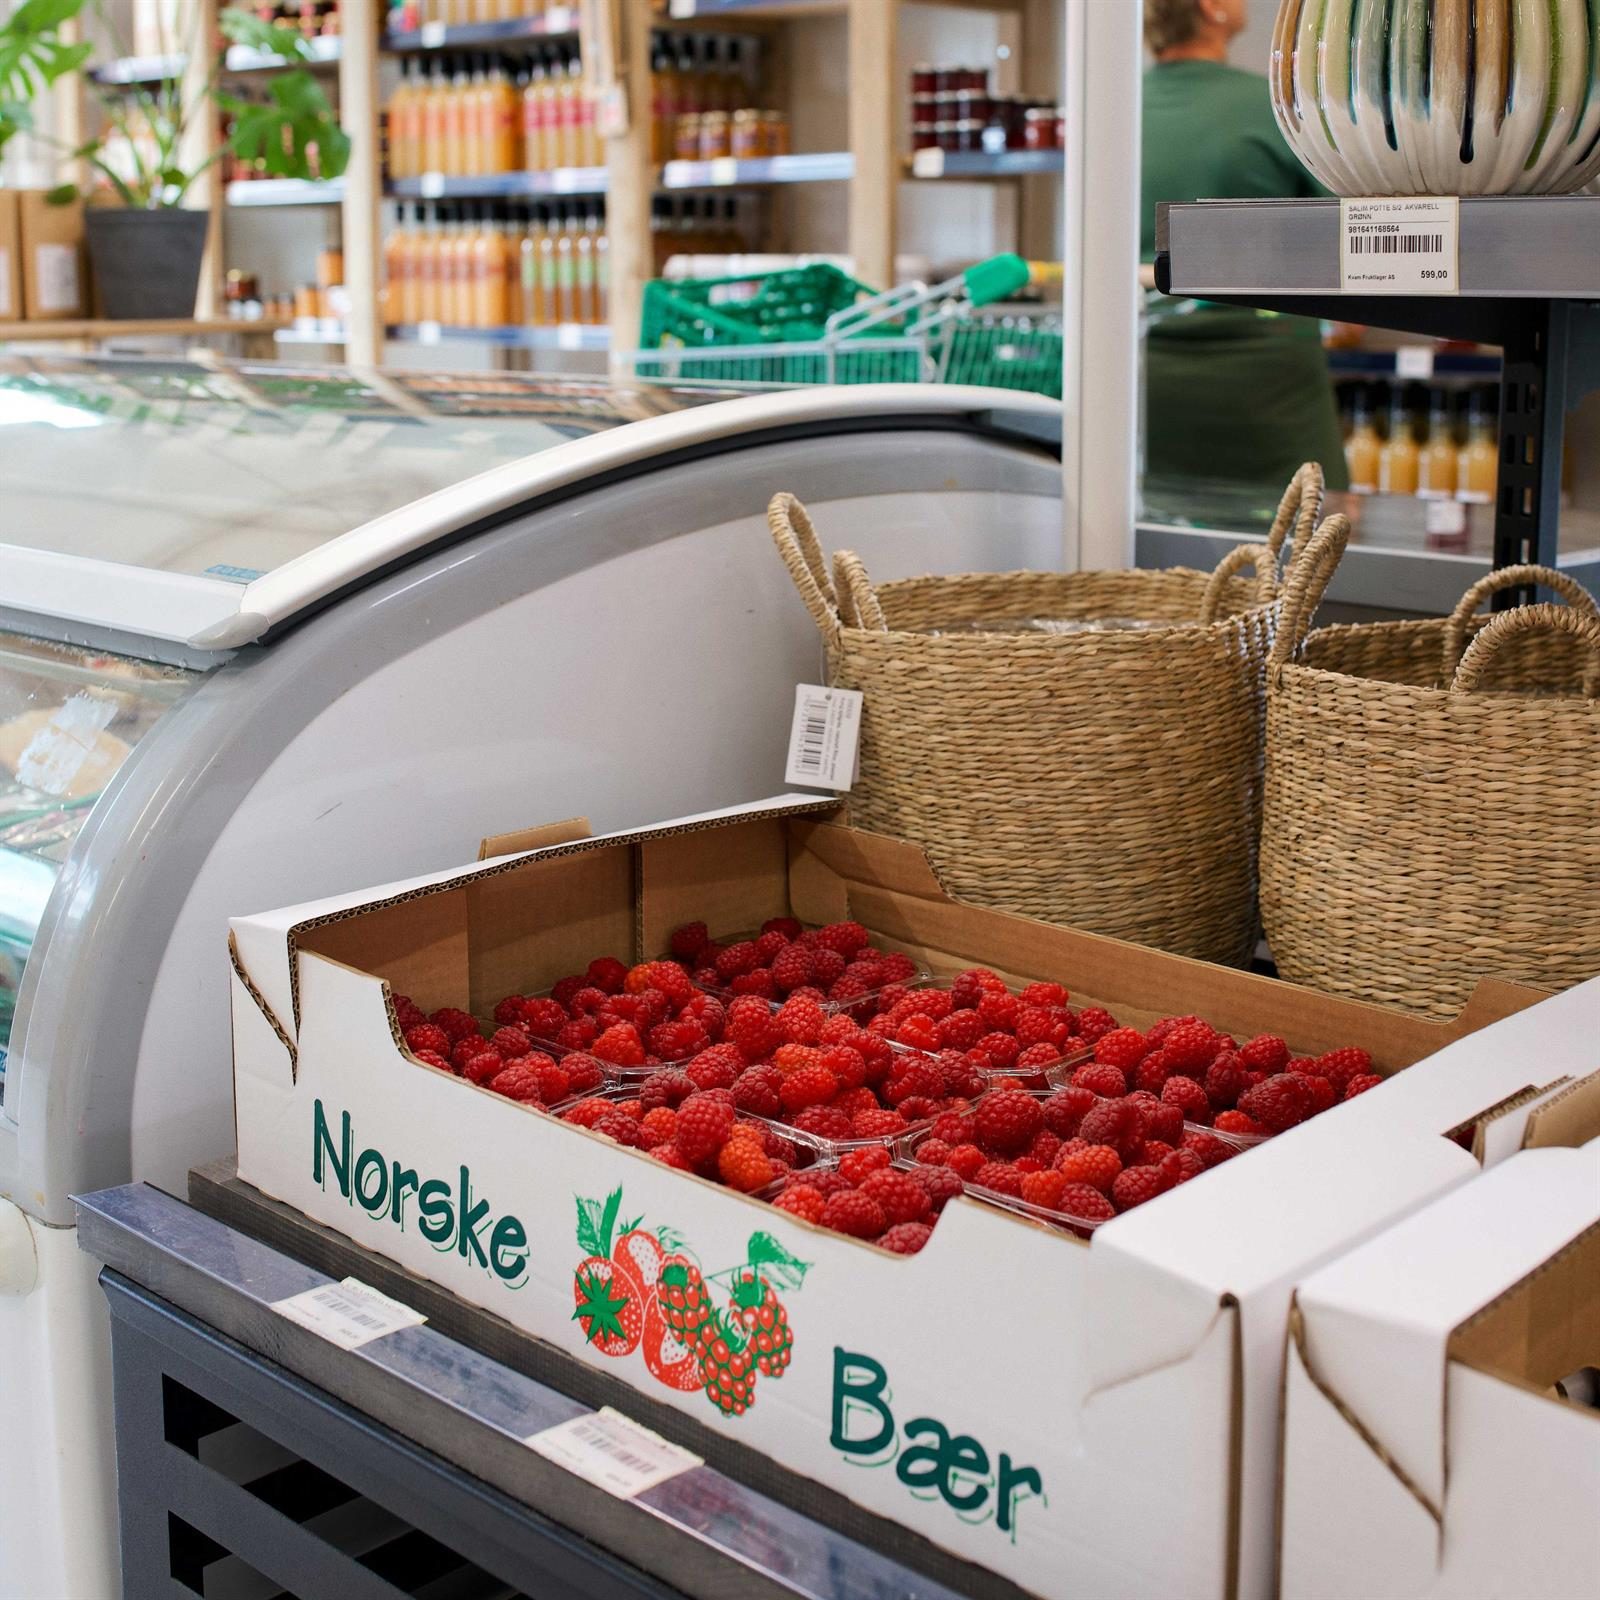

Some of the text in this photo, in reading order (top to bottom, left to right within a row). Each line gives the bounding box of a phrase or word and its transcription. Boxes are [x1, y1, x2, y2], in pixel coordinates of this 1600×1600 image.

[1348, 225, 1400, 233] 981641168564
[1420, 270, 1448, 280] 599,00
[313, 1098, 1044, 1538] Norske Bær
